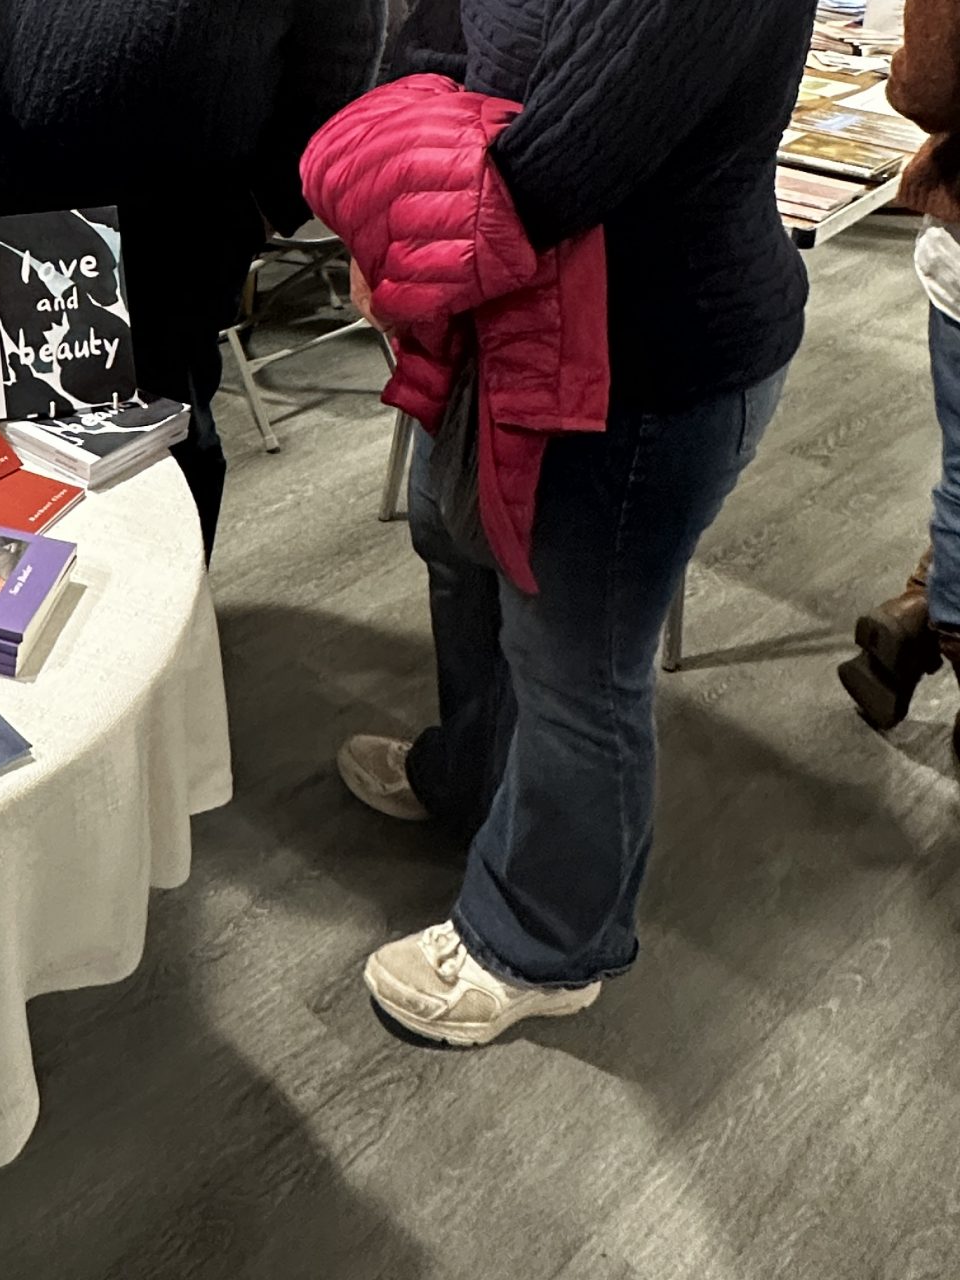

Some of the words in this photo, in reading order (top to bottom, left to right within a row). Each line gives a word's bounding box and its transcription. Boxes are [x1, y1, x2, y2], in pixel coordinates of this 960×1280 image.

[21, 250, 100, 284] love
[36, 286, 78, 312] and
[18, 327, 120, 370] beauty
